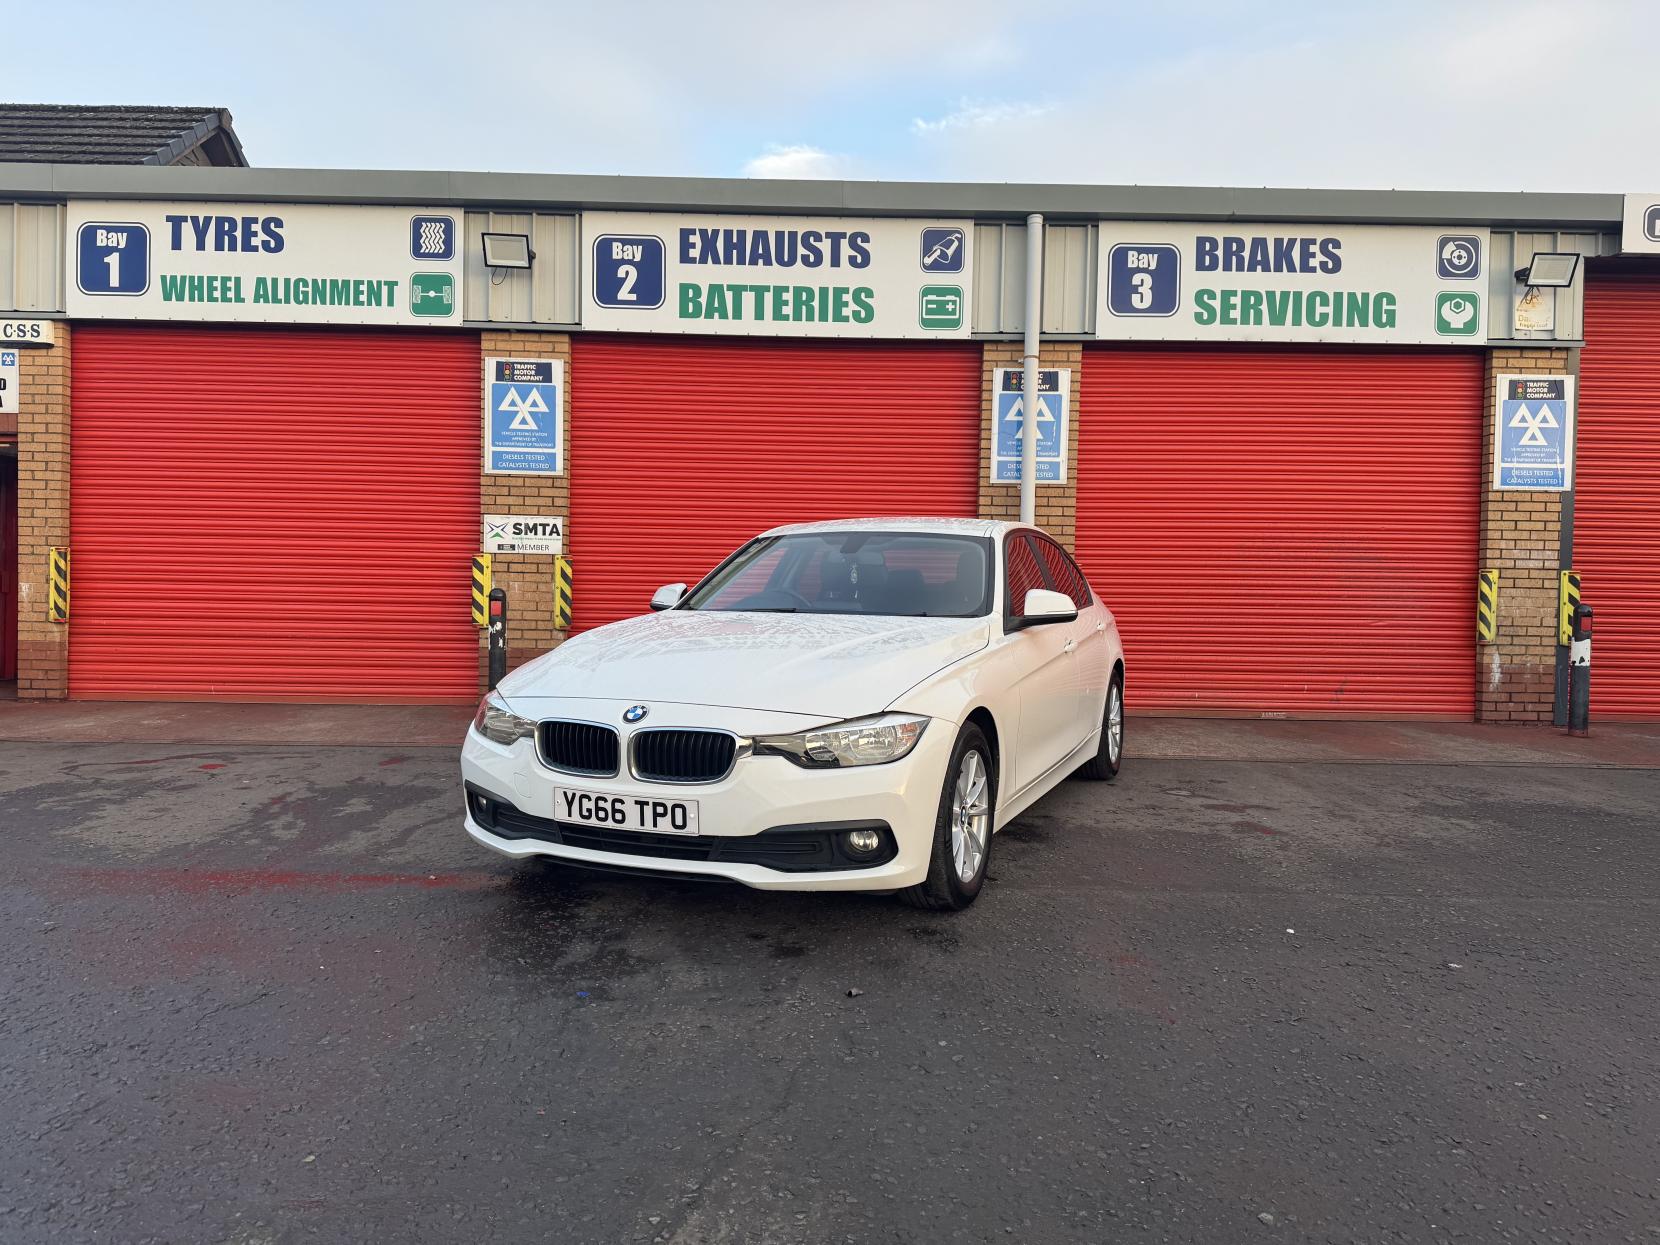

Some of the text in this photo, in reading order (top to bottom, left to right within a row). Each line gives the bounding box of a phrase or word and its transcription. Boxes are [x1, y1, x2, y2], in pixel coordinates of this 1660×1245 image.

[96, 230, 128, 248] Bay
[165, 215, 285, 253] TYRES
[612, 242, 643, 262] Bay
[678, 228, 871, 269] EXHAUSTS
[104, 252, 120, 288] 1
[1127, 250, 1159, 270] Bay
[1195, 236, 1342, 275] BRAKES
[160, 274, 400, 308] WHEEL ALIGNMENT
[617, 264, 638, 300] 2
[1131, 272, 1153, 310] 3
[677, 283, 876, 325] BATTERIES
[1193, 288, 1397, 330] SERVICING
[512, 522, 561, 537] SMTA
[517, 543, 550, 551] MEMBER
[563, 791, 688, 830] YG66 TPO
